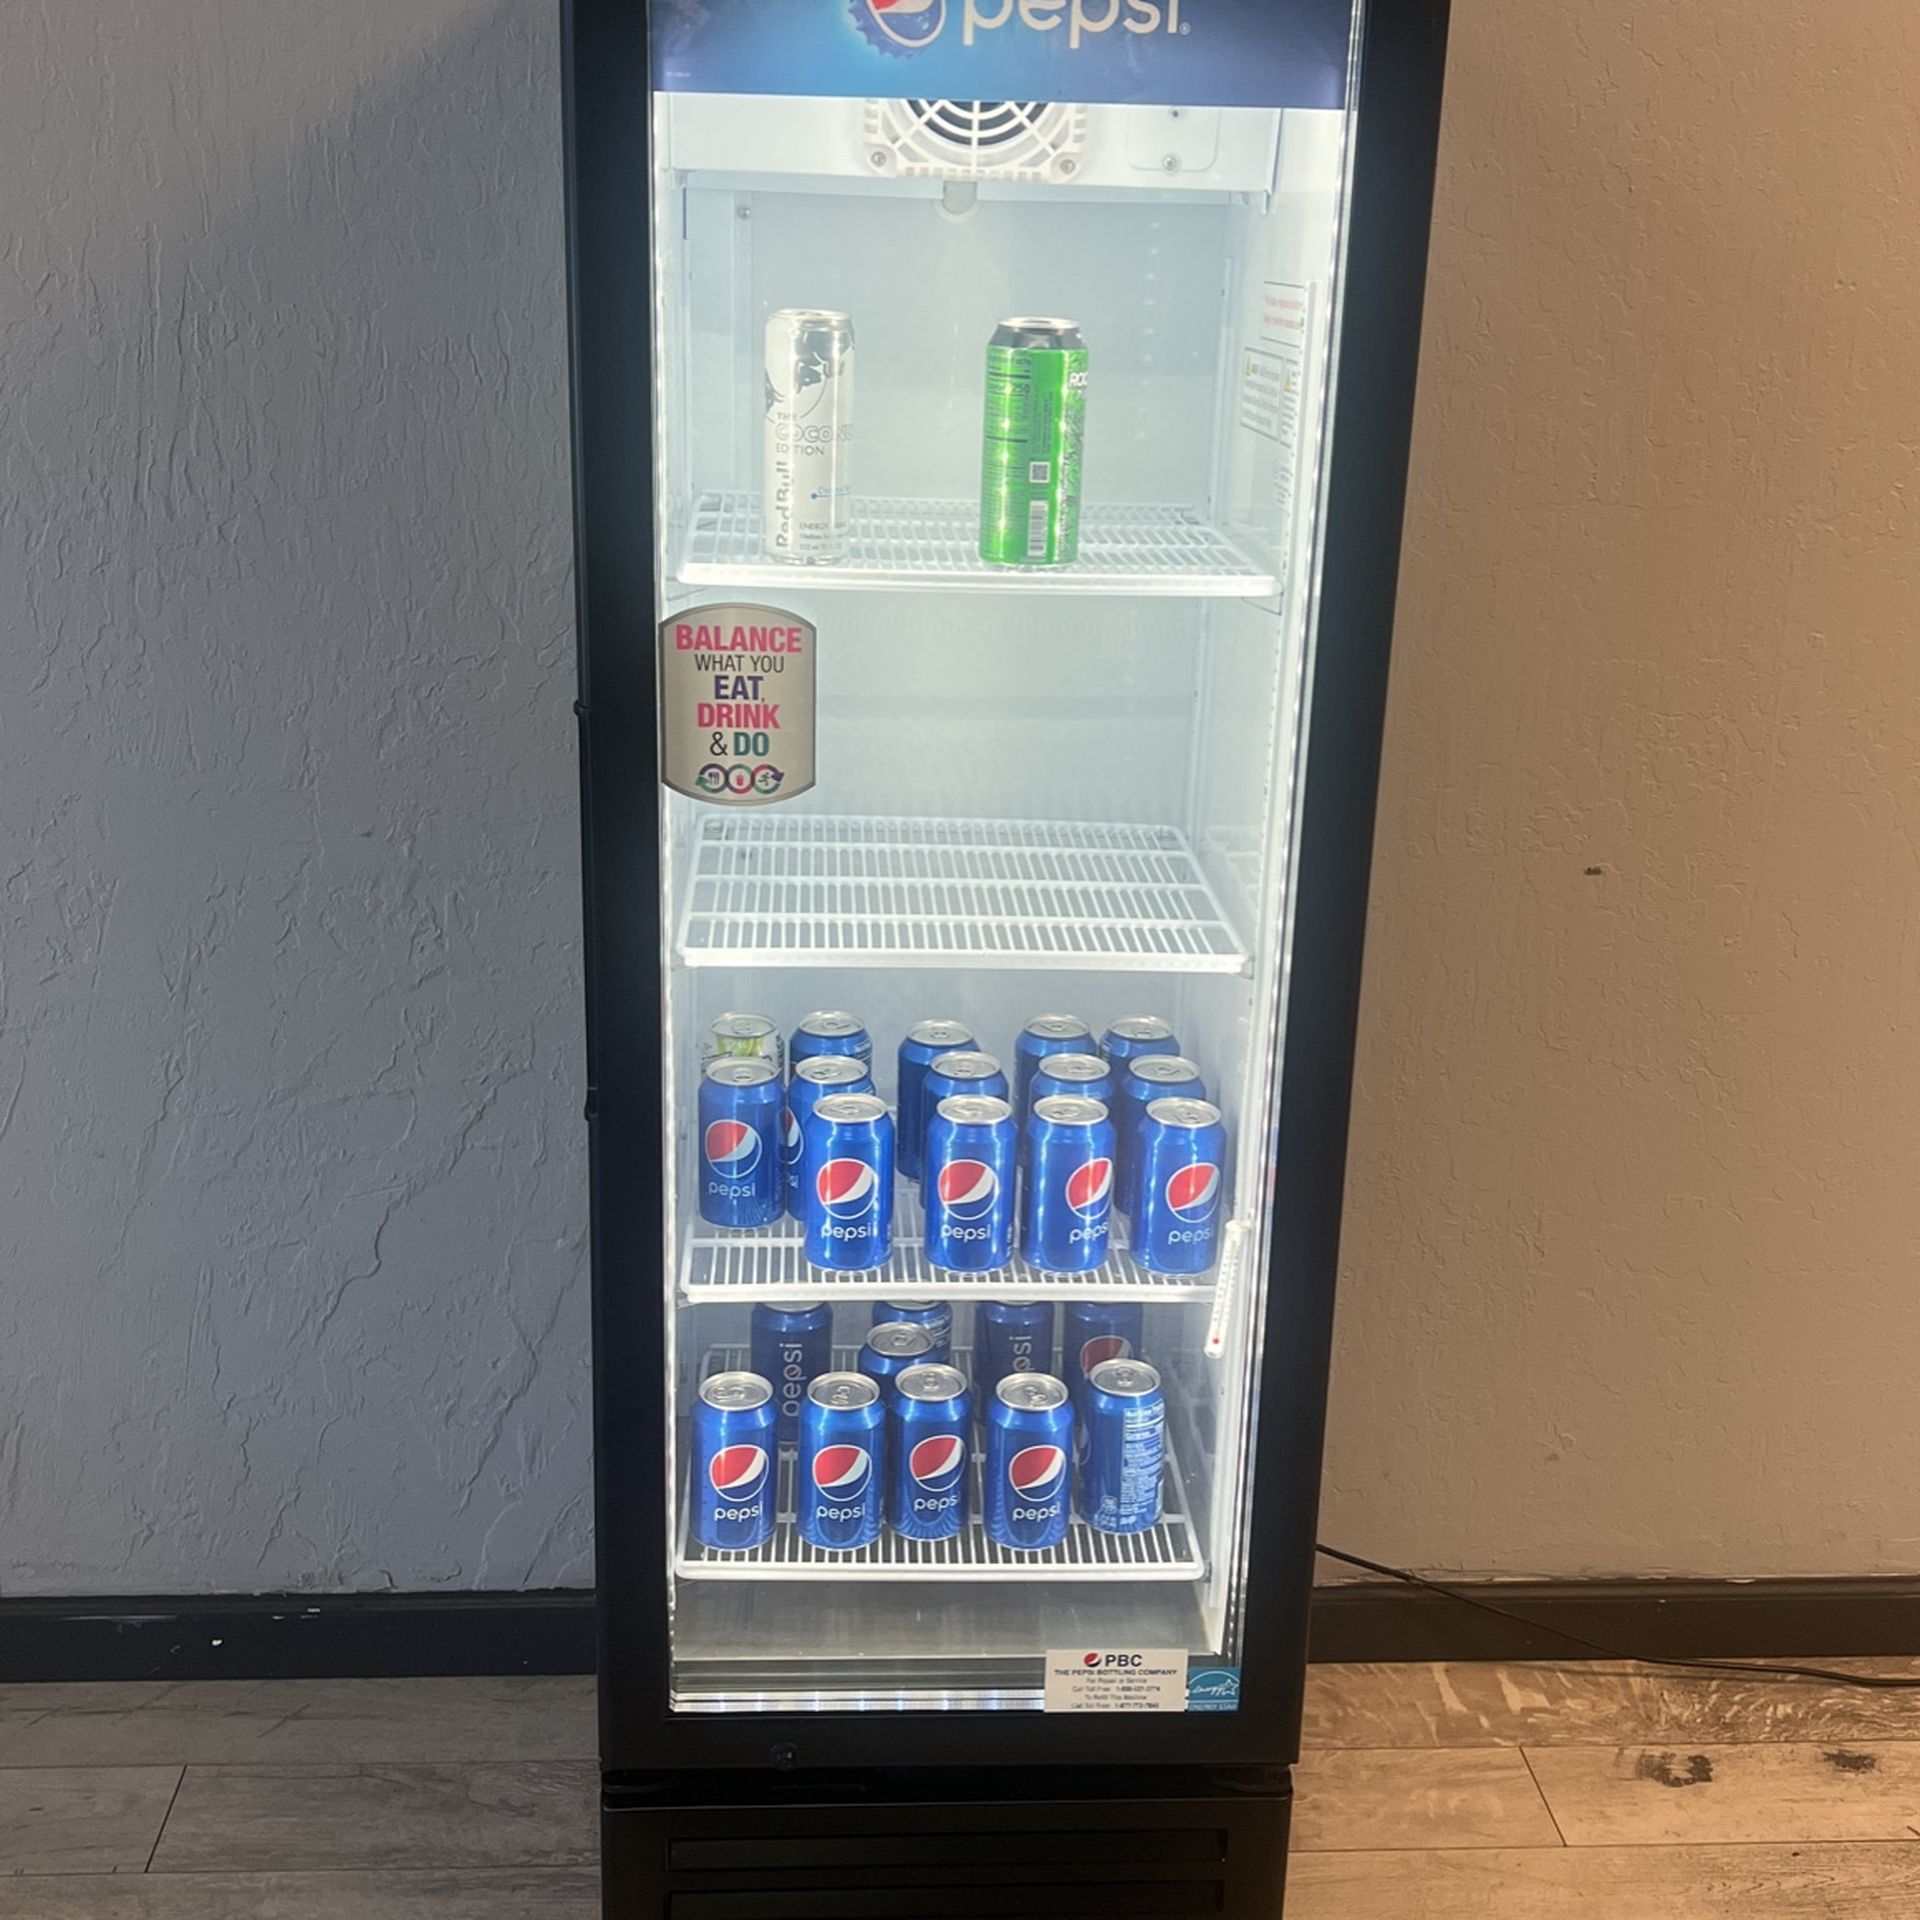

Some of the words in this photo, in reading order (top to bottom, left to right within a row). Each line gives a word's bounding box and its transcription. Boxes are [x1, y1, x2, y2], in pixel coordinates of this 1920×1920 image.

[675, 624, 803, 653] BALANCE
[695, 654, 745, 672] WHAT
[750, 655, 785, 673] YOU
[697, 703, 781, 729] DRINK
[709, 731, 728, 756] &
[733, 731, 770, 757] DO
[708, 1181, 757, 1199] pepsi
[820, 1222, 873, 1242] pepsi
[940, 1223, 992, 1243] pepsi
[1168, 1224, 1214, 1245] pepsi
[1009, 1335, 1035, 1372] psi
[714, 1502, 763, 1523] pepsi
[816, 1502, 866, 1523] pepsi
[1012, 1501, 1061, 1522] pepsi
[1105, 1654, 1143, 1668] PBC
